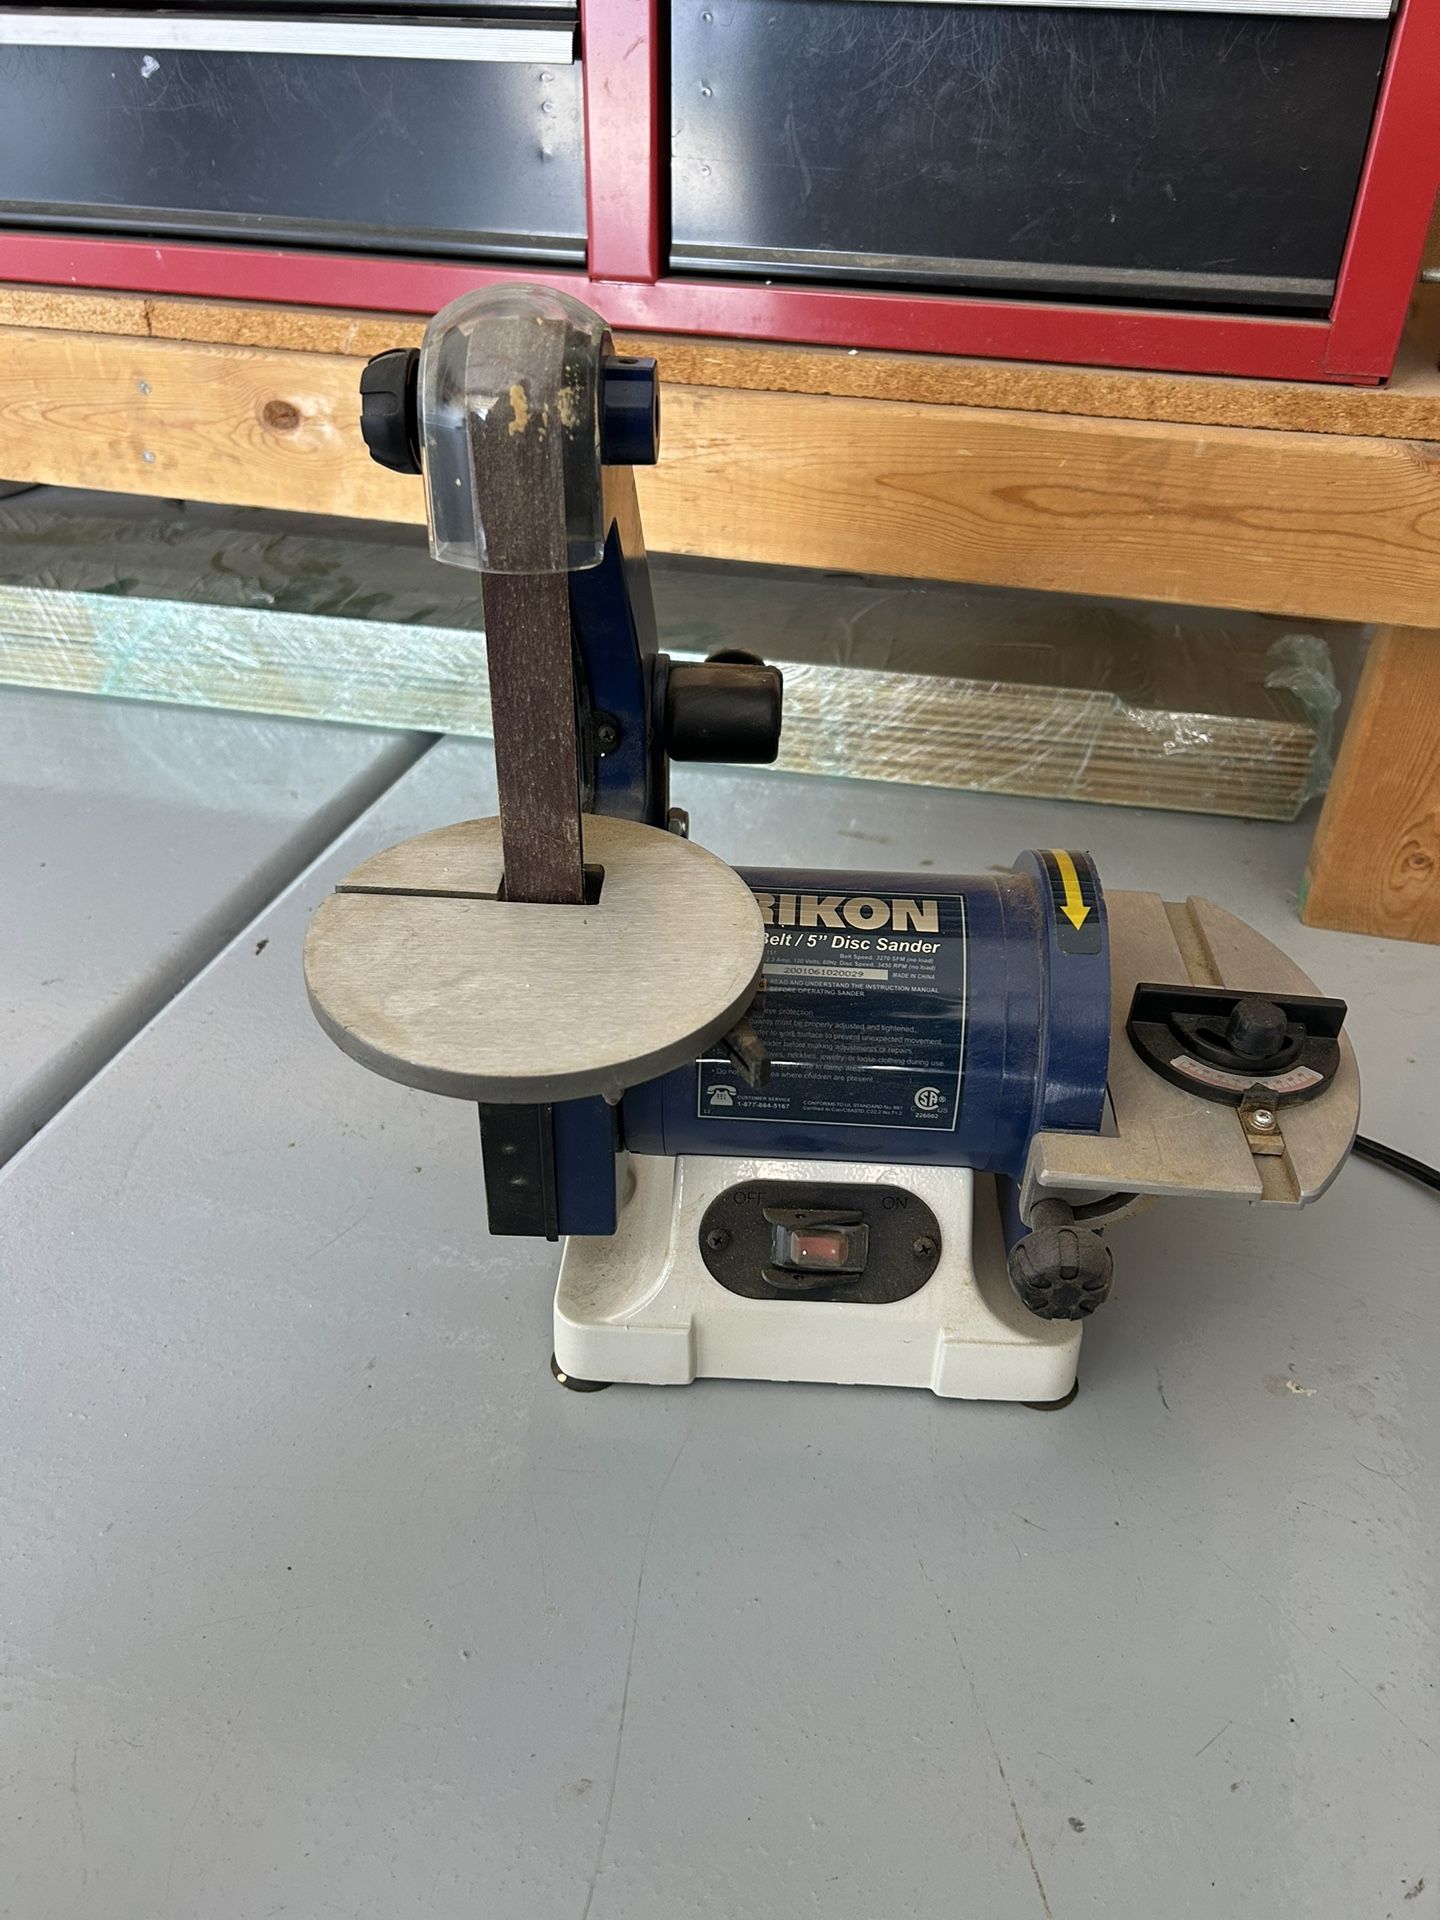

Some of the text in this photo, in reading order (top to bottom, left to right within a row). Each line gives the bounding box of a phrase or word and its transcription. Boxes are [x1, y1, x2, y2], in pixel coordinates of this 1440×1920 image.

[795, 934, 804, 947] /
[831, 935, 871, 950] Disc
[876, 937, 941, 954] Sander
[892, 971, 909, 979] MADE
[769, 978, 940, 994] READ AND UNDERSTAND THE INSTRUCTION MANUAL
[798, 986, 836, 996] OPERATING
[837, 989, 865, 997] SANDER
[834, 1022, 865, 1031] adjusted
[861, 1035, 903, 1044] unexpected
[733, 1191, 766, 1205] OFF
[883, 1196, 907, 1210] ON
